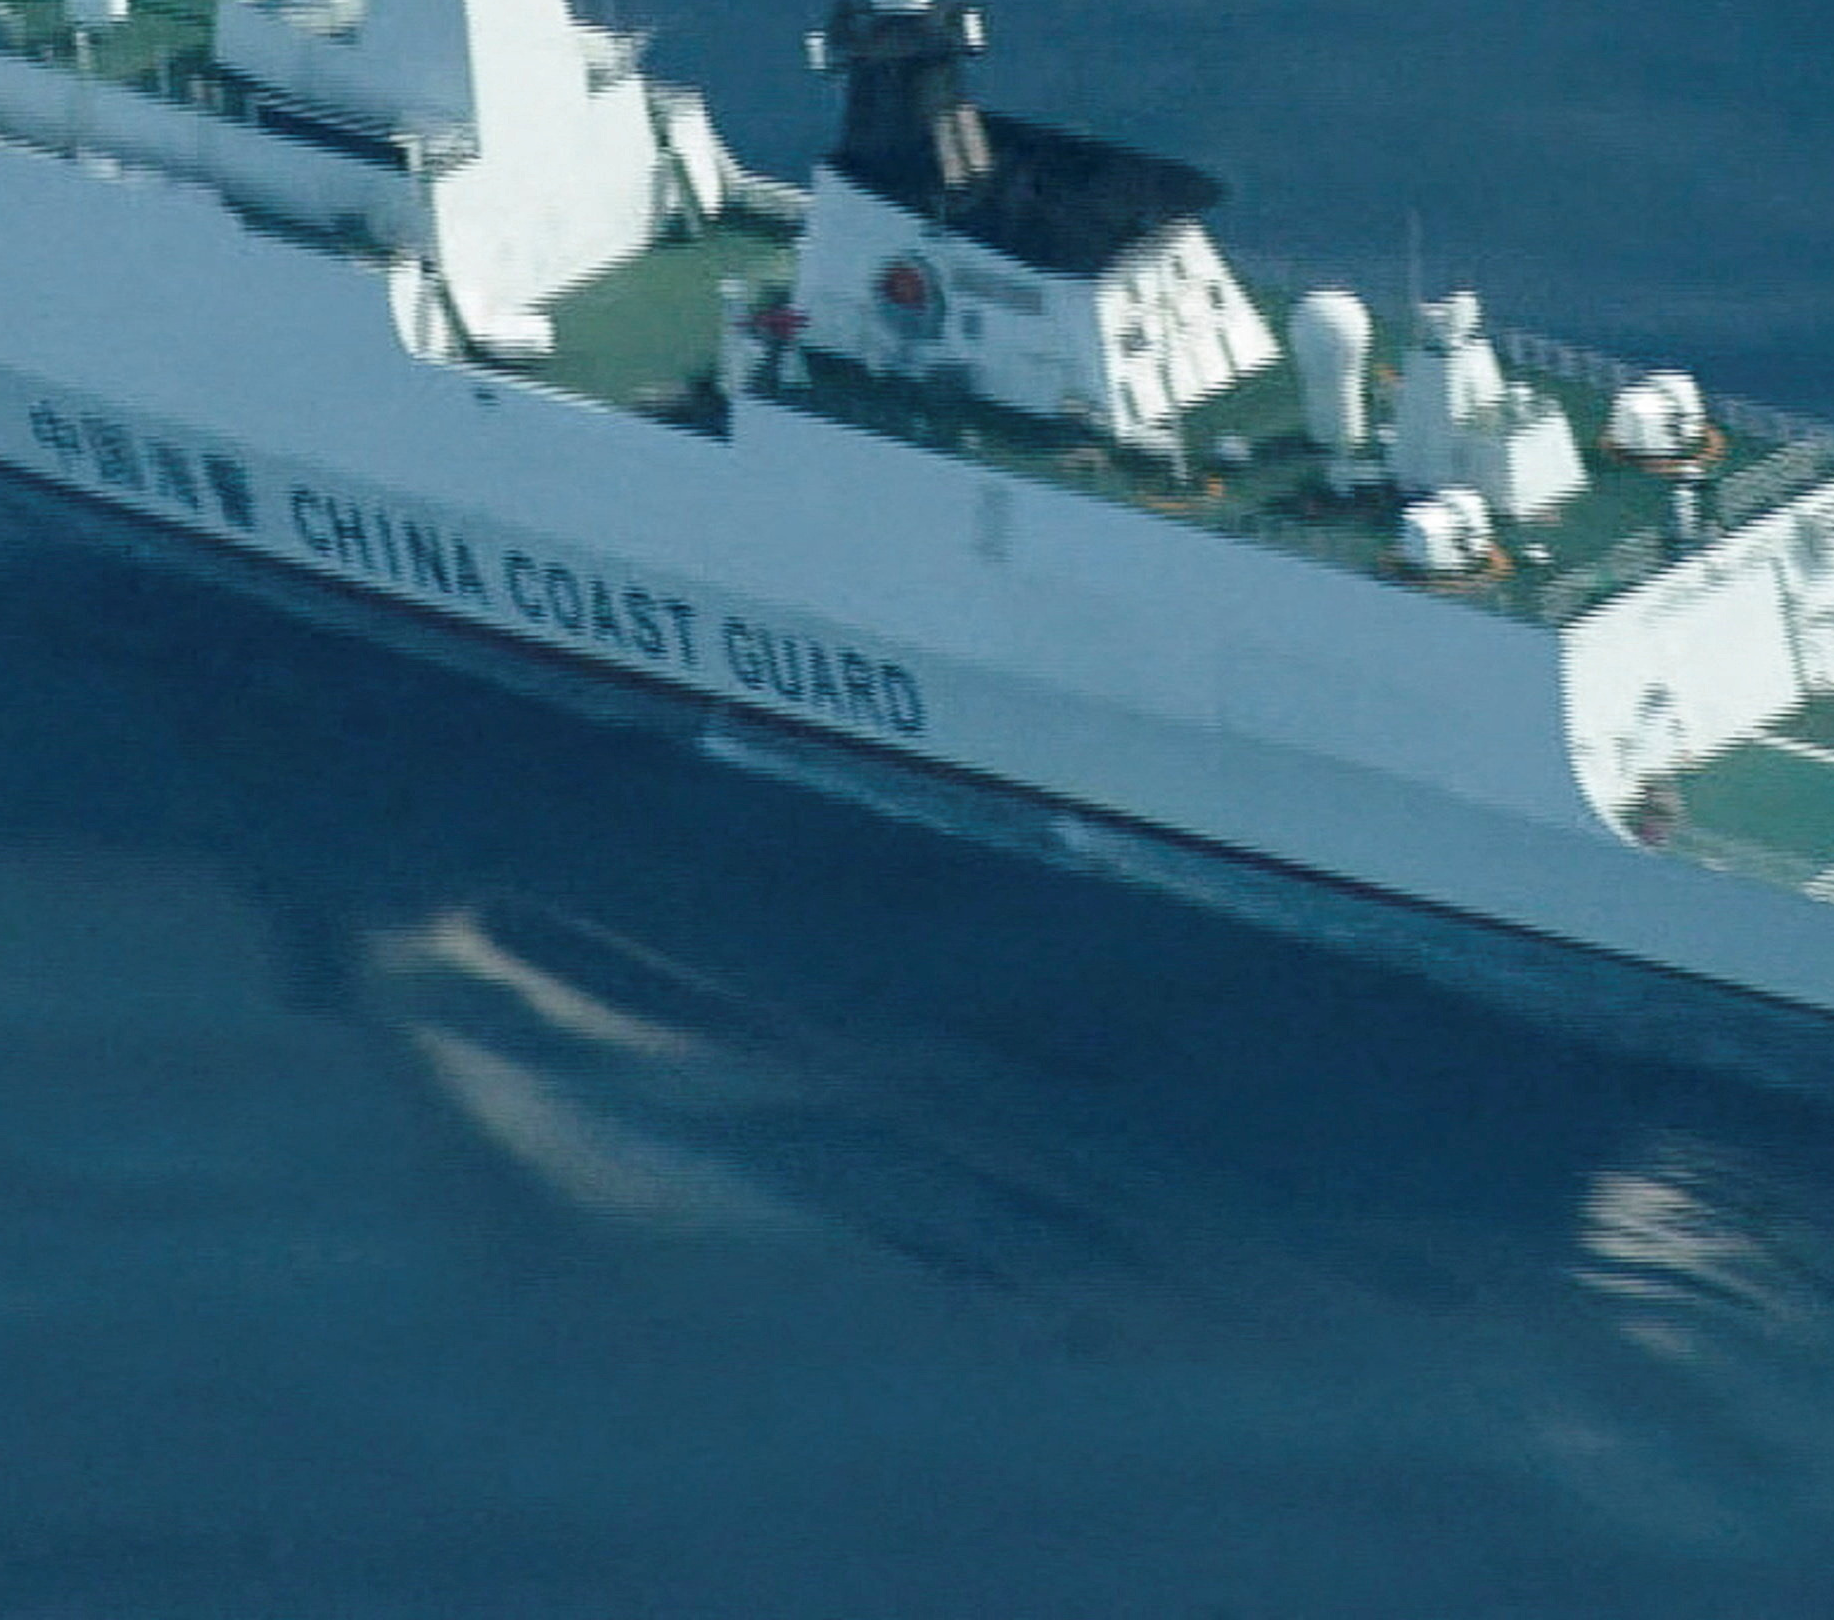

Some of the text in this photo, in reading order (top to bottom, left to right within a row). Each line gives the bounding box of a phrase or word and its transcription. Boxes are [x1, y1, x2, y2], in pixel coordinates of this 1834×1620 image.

[290, 489, 925, 736] CHINA COAST GUARD
